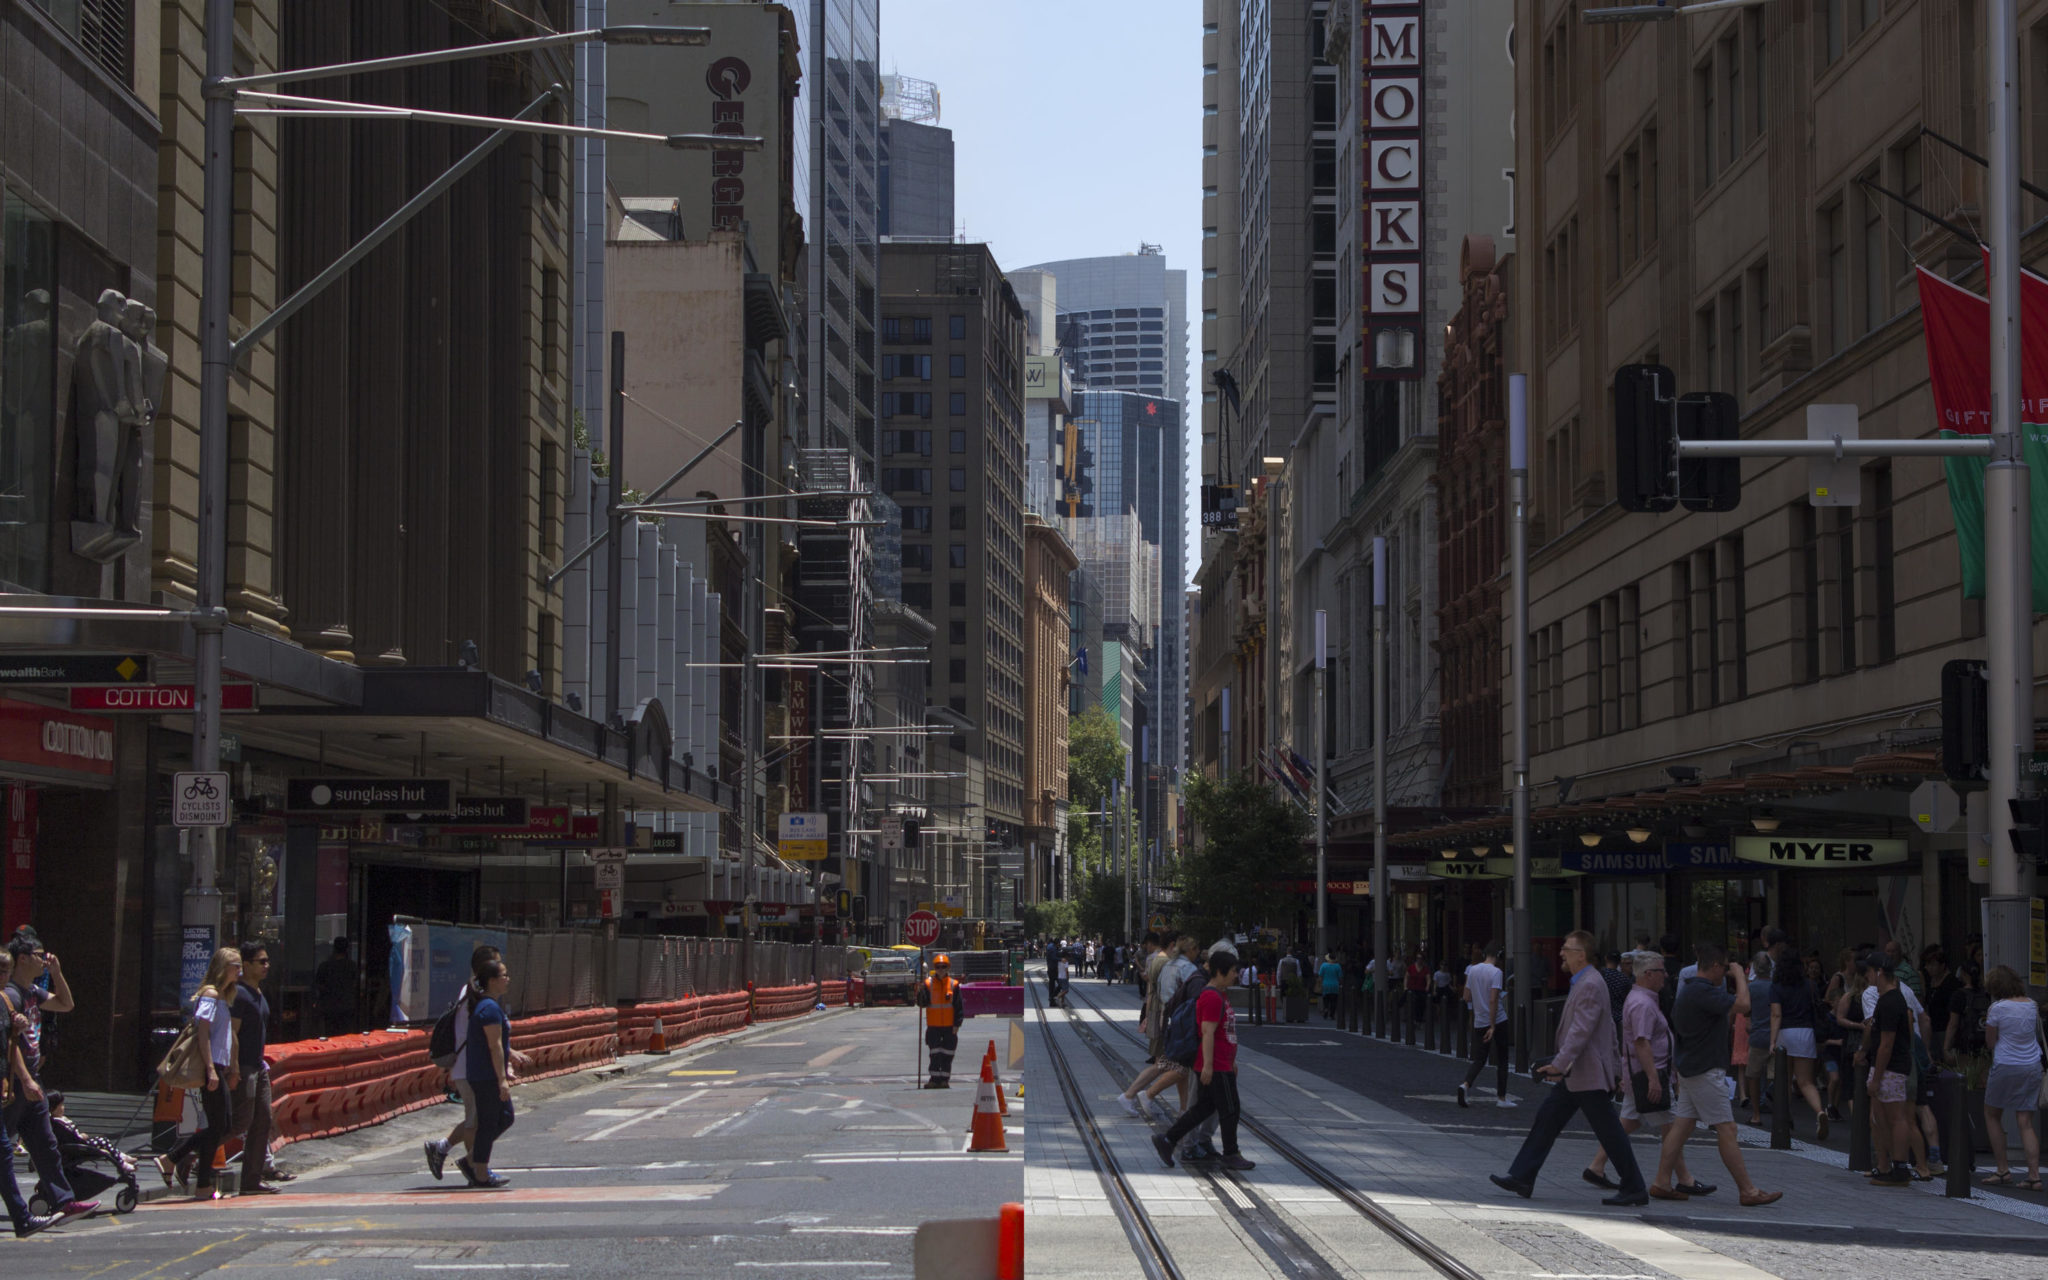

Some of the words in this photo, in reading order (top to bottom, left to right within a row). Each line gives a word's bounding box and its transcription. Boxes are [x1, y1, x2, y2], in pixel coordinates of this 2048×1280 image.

[1373, 23, 1416, 306] MOCKS
[1203, 511, 1222, 524] 388
[105, 688, 188, 706] COTTON
[43, 720, 95, 760] COTTON
[95, 730, 113, 761] ON
[335, 786, 399, 806] sunglass
[401, 786, 426, 802] hut
[181, 802, 221, 811] CYCLISTS
[483, 802, 504, 817] hut
[179, 812, 222, 821] DISMOUNT
[1769, 842, 1874, 862] MYER
[1446, 863, 1485, 875] MYE
[1580, 853, 1674, 870] SAMSUN
[906, 918, 938, 937] STOP
[182, 950, 212, 961] PRYDZ
[182, 970, 207, 980] JONE
